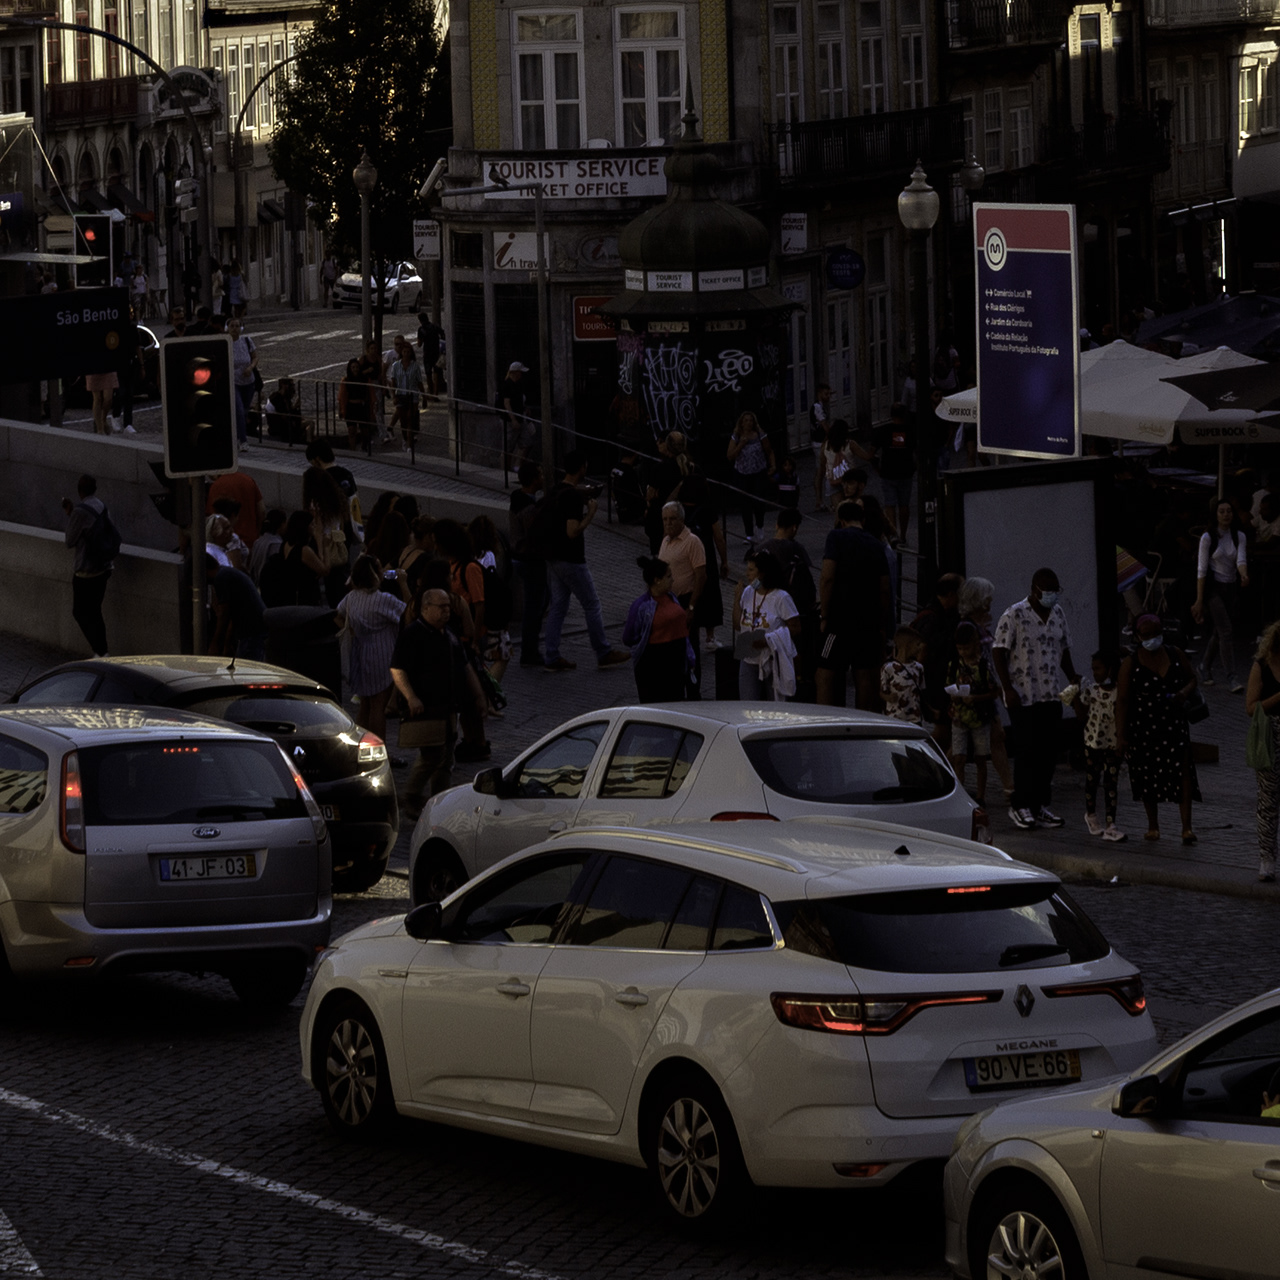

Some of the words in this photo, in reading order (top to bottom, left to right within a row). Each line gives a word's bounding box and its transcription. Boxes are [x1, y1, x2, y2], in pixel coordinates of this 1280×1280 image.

[576, 159, 659, 178] SERVICE
[575, 181, 629, 196] OFFICE
[1014, 289, 1026, 298] Local
[990, 302, 999, 311] Rua
[56, 310, 80, 326] São
[82, 306, 119, 324] Bento
[990, 318, 1005, 326] Jardim
[991, 343, 1009, 352] Instituto
[1037, 345, 1059, 356] Fotografia
[948, 407, 960, 416] SUPER
[960, 407, 972, 417] BOCK
[1195, 427, 1220, 437] SUPER
[1222, 427, 1245, 437] BOCK
[996, 1039, 1058, 1052] MEGANE
